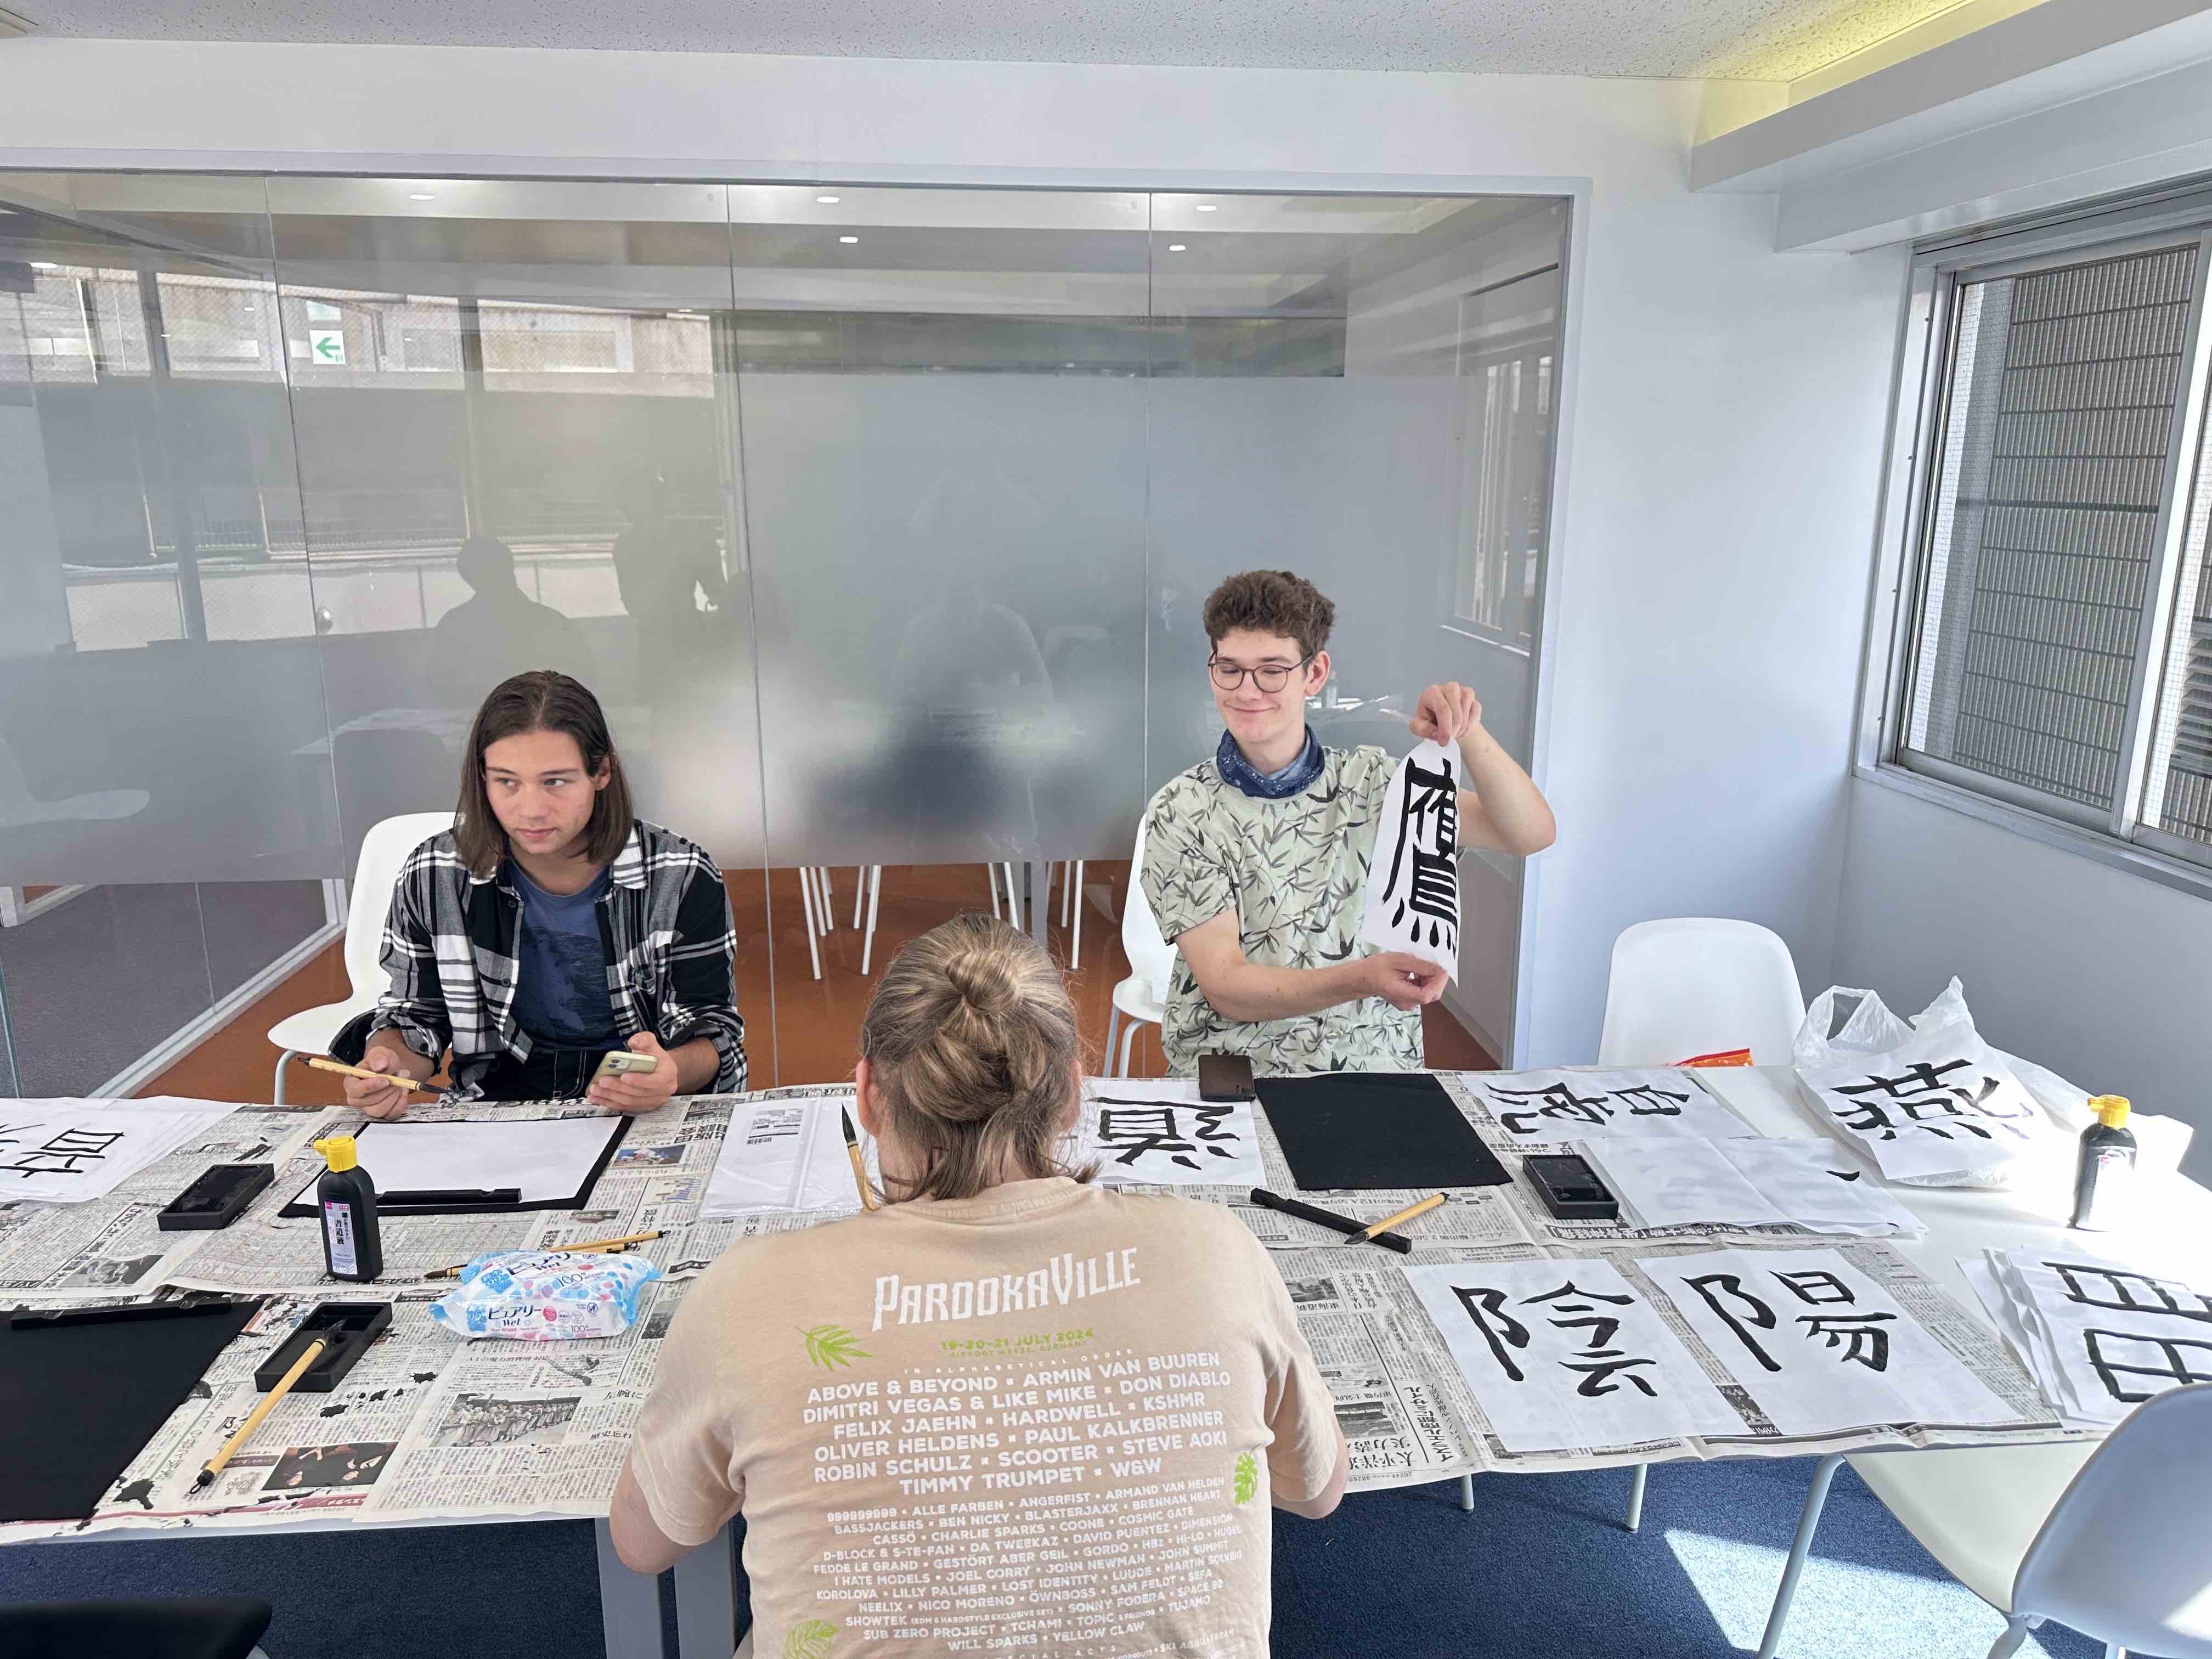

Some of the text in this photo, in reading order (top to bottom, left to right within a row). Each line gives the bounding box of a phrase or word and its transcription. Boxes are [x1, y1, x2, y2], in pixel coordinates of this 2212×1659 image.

[488, 1305, 542, 1320] ピュアリー
[1679, 1270, 1897, 1372] 陽
[1017, 1332, 1051, 1346] JULY
[1057, 1328, 1093, 1343] 2024
[1450, 1280, 1658, 1397] 陰
[808, 1352, 1220, 1404] ABOVE & BEYOND ARMIN VAN BUUREN
[935, 1358, 1068, 1373] ALPHABETICAL
[1081, 1348, 1133, 1361] ORDER
[803, 1372, 1231, 1424] DIMITRI VEGAS & LIKE MIKE DON DIABLO
[833, 1391, 1205, 1440] FELIX JAEHN HARDWELL KSHMR
[814, 1410, 1224, 1462] OLIVER HELDENS PAUL KALKBRENNER
[814, 1430, 1227, 1483] ROBIN SCHULZ SCOOTER STEVE AOKI
[899, 1457, 1161, 1496] TIMMY TRUMPET W&W
[912, 1503, 946, 1516] ALLE
[951, 1500, 1004, 1513] FARBEN
[1019, 1492, 1090, 1508] ANGERFIST
[1105, 1486, 1158, 1500] ARMAND
[1162, 1481, 1185, 1493] VAN
[1188, 1477, 1224, 1489] HELDEN
[834, 1490, 1221, 1535] BASSJACKERS BEN NICKY BLASTERJAXX BRENNAN HEART
[873, 1506, 1194, 1545] CASSÖ CHARLIE SPARKS COONE COSMIC GATE
[813, 1560, 851, 1575] FEDDE
[855, 1560, 868, 1572] LE
[873, 1559, 918, 1572] GRAND
[934, 1554, 994, 1569] GESTÖRT
[1000, 1551, 1035, 1564] ABER
[1040, 1549, 1069, 1561] GEIL
[1084, 1542, 1128, 1557] GORDO
[1176, 1531, 1204, 1544] HI-LO
[823, 1548, 876, 1561] D-BLOCK
[893, 1544, 954, 1558] S-TE-FAN
[970, 1542, 990, 1553] DA
[995, 1536, 1059, 1550] TWEEKAZ
[1073, 1531, 1111, 1544] DAVID
[1116, 1523, 1170, 1539] PUENTEZ
[1181, 1514, 1233, 1531] DIMENSION
[816, 1589, 878, 1601] KOROLOVA
[893, 1587, 927, 1598] LILLY
[932, 1583, 986, 1596] PALMER
[1002, 1579, 1035, 1592] LOST
[1040, 1575, 1098, 1588] IDENTITY
[1113, 1567, 1152, 1581] LUUDE
[1165, 1559, 1205, 1573] MARTIN
[842, 1575, 872, 1585] HATE
[877, 1573, 930, 1585] MODELS
[946, 1570, 979, 1583] JOEL
[986, 1566, 1031, 1579] CORRY
[1045, 1561, 1083, 1575] JOHN
[1088, 1554, 1146, 1570] NEWMAN
[1158, 1546, 1190, 1561] JOHN
[1193, 1540, 1229, 1555] SUMMIT
[846, 1615, 907, 1627] SHOWTEK
[1068, 1599, 1112, 1613] SONNY
[1117, 1592, 1166, 1607] FODERA
[1178, 1582, 1209, 1597] SPACE
[859, 1602, 903, 1613] NEELIX
[918, 1599, 950, 1611] NICO
[955, 1595, 1015, 1609] MORENO
[1110, 1582, 1137, 1595] SAM
[1141, 1576, 1176, 1590] FELDT
[1188, 1570, 1212, 1582] SEFA
[864, 1629, 889, 1640] SUB
[894, 1628, 929, 1639] ZERO
[933, 1624, 996, 1638] PROJECT
[1010, 1618, 1062, 1633] TCHAMI
[1076, 1613, 1114, 1626] TOPIC
[1167, 1595, 1211, 1612] TUJAMO
[947, 1621, 1145, 1651] WILL SPARKS YELLOW CLAW
